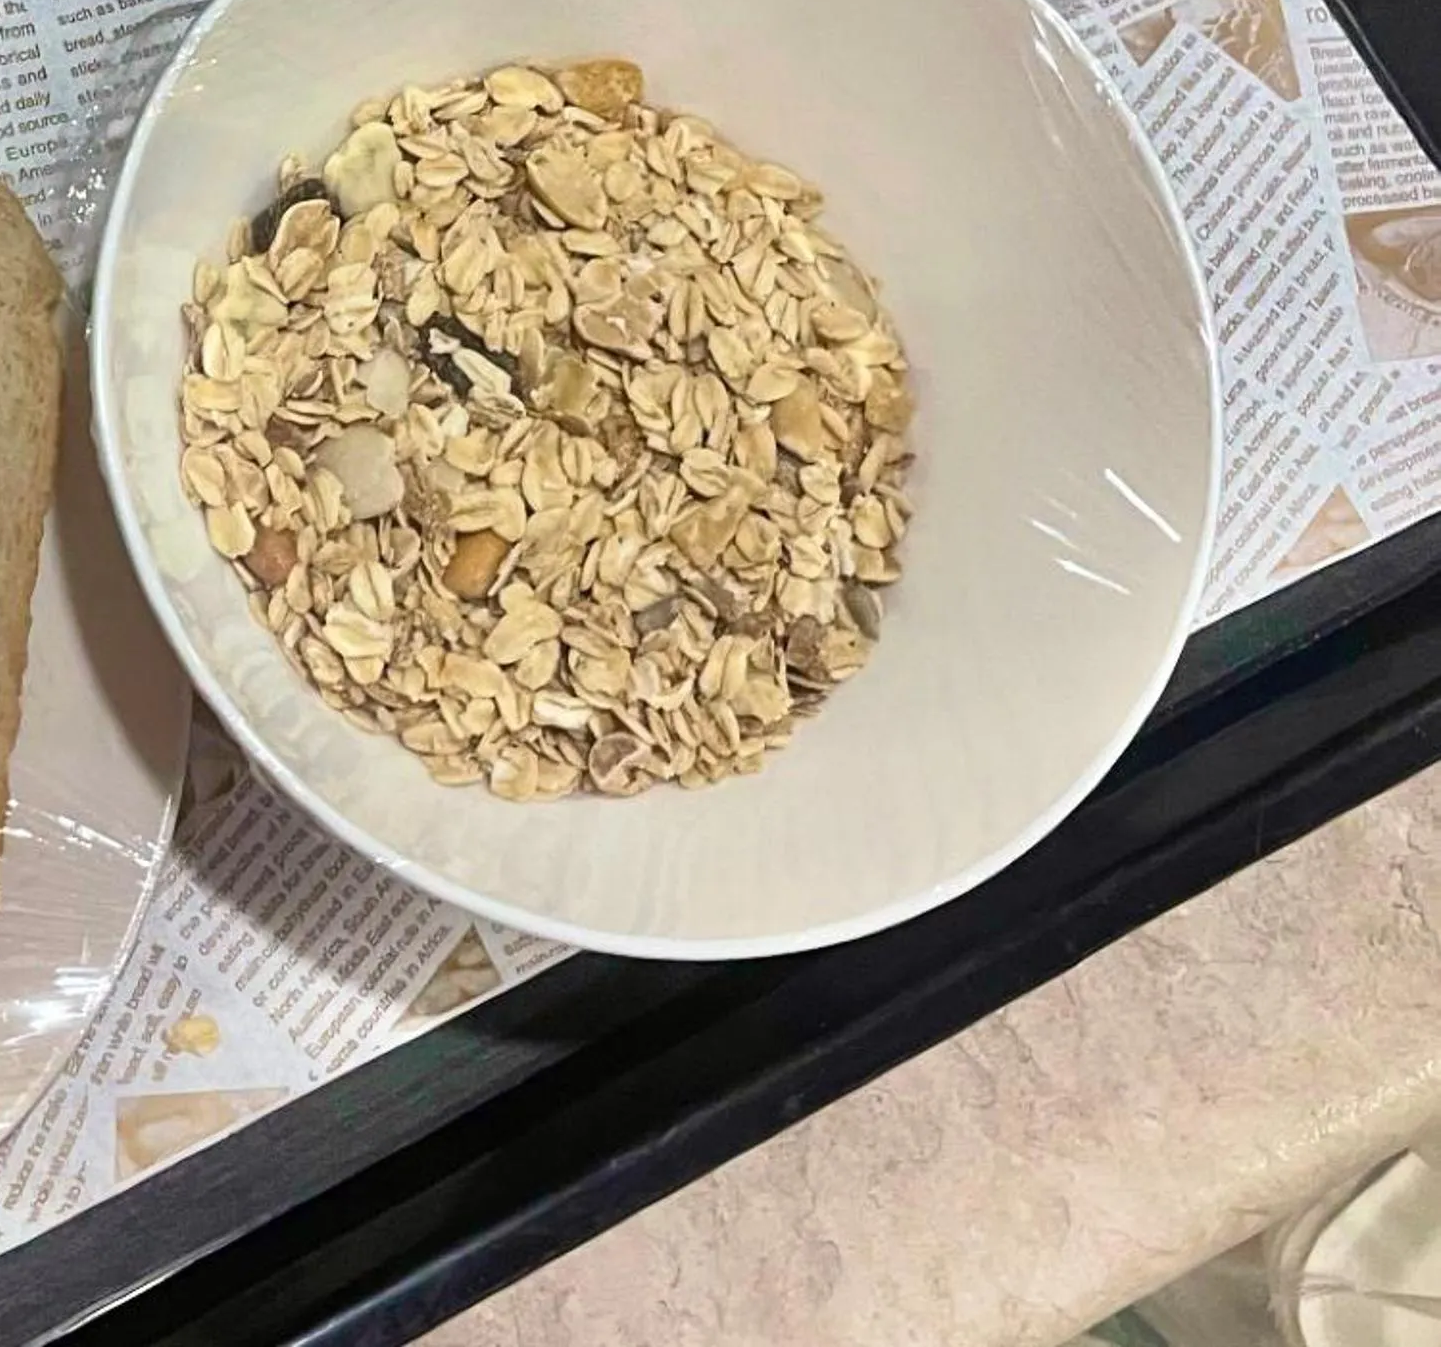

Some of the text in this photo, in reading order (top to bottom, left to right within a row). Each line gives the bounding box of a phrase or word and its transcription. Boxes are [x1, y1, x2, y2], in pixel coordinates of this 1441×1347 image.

[58, 8, 93, 26] such
[96, 2, 115, 17] as
[0, 21, 36, 47] from
[17, 65, 48, 85] and
[14, 90, 51, 114] daily
